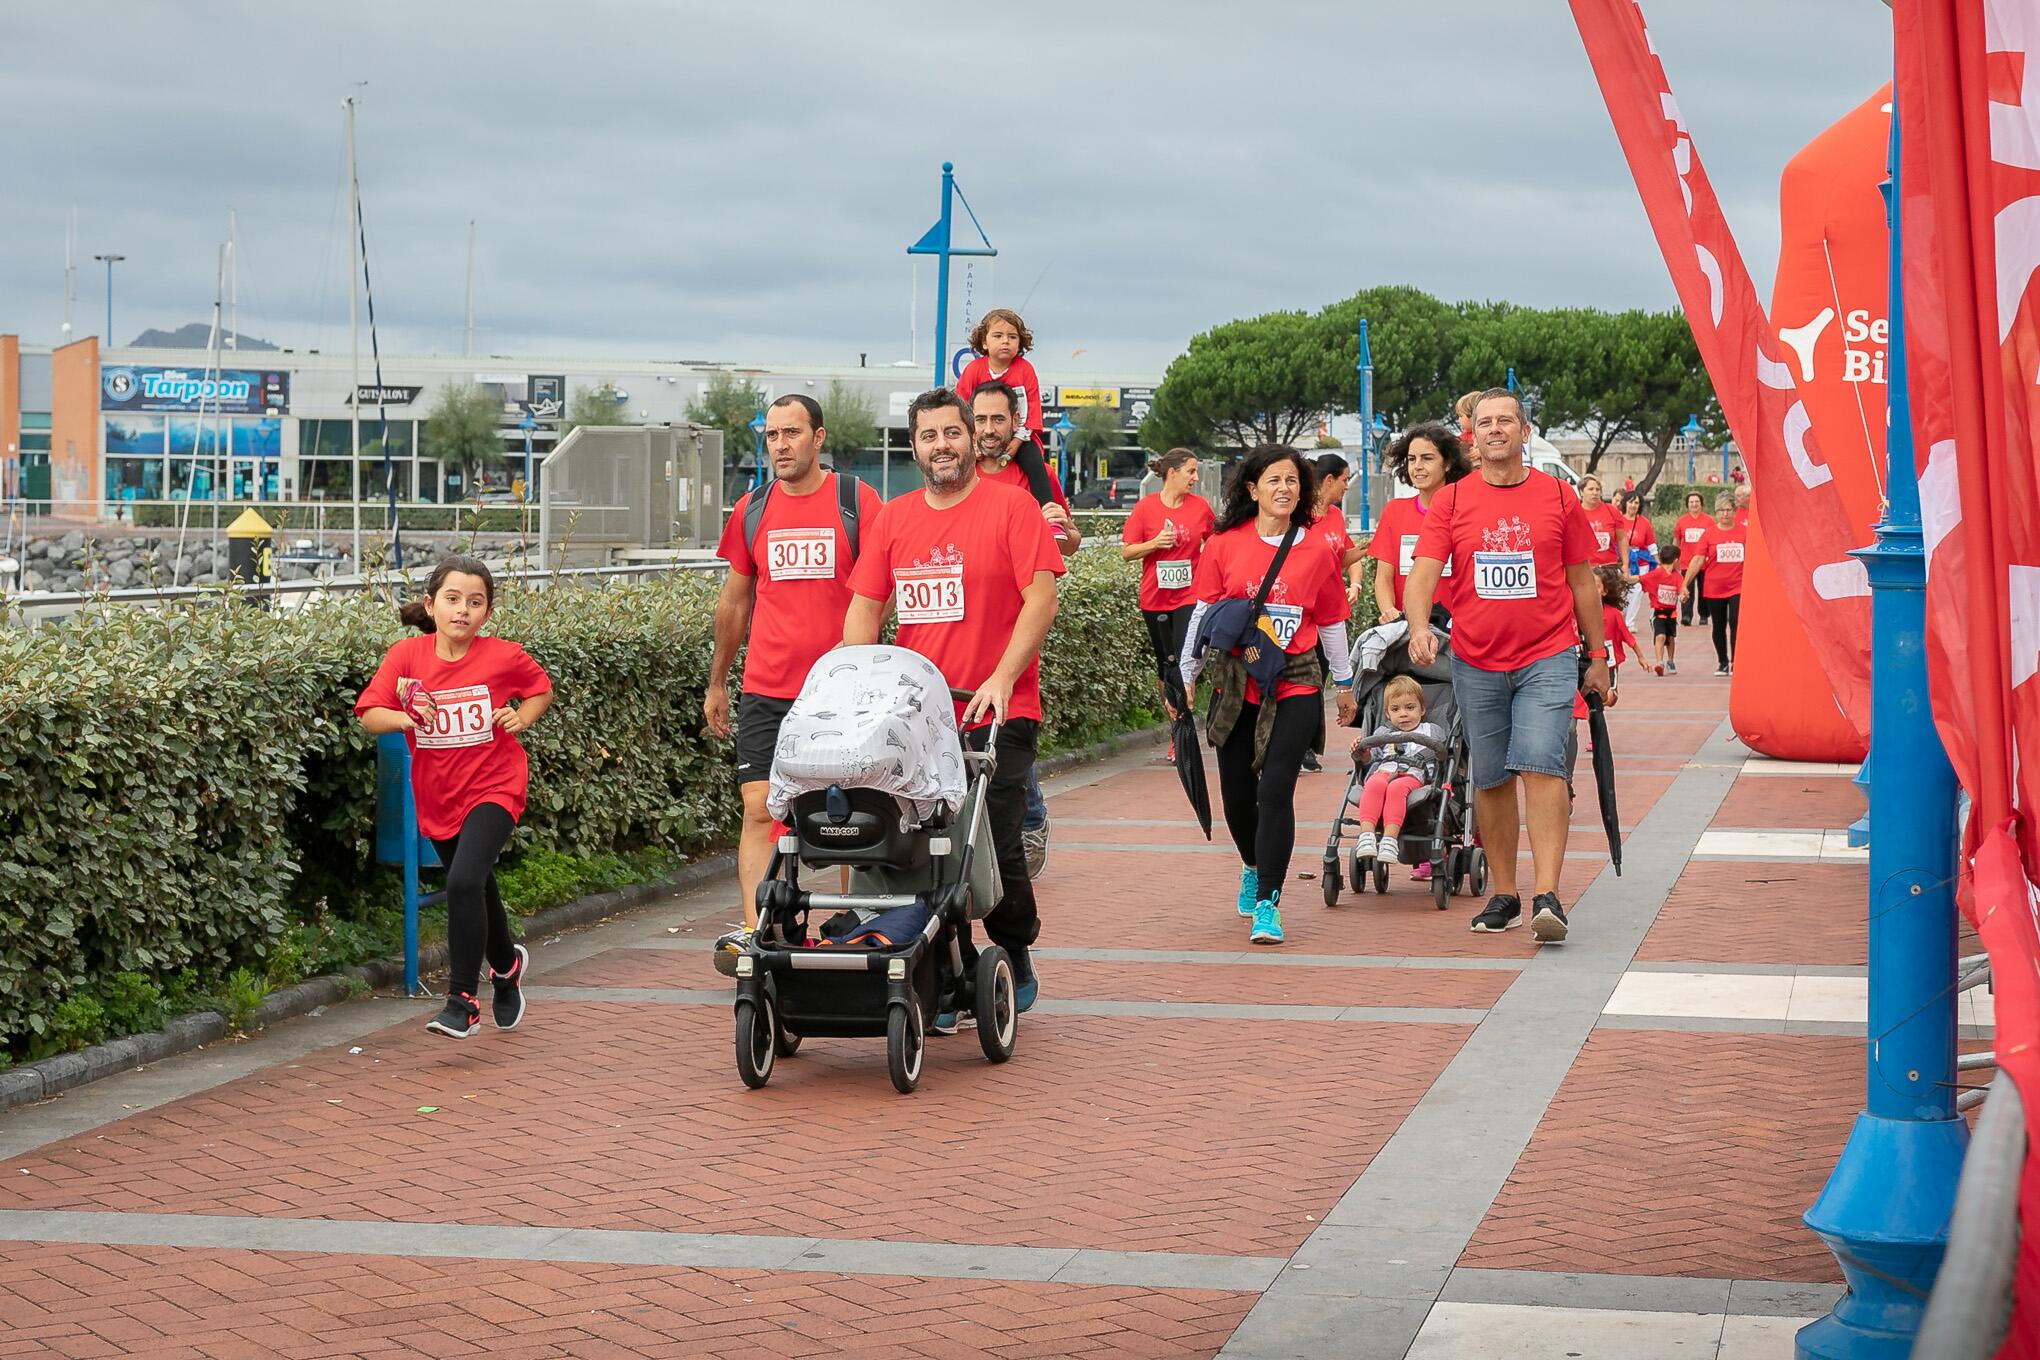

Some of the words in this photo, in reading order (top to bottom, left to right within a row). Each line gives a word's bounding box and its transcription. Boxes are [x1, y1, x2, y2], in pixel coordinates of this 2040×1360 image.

[1842, 350, 1888, 384] Bi
[142, 374, 249, 403] Tarpoon
[775, 543, 827, 567] 3013
[1720, 549, 1742, 558] 3002
[1161, 567, 1189, 581] 2009
[1481, 565, 1529, 587] 1006
[903, 581, 957, 609] 3013
[1273, 618, 1296, 639] 06
